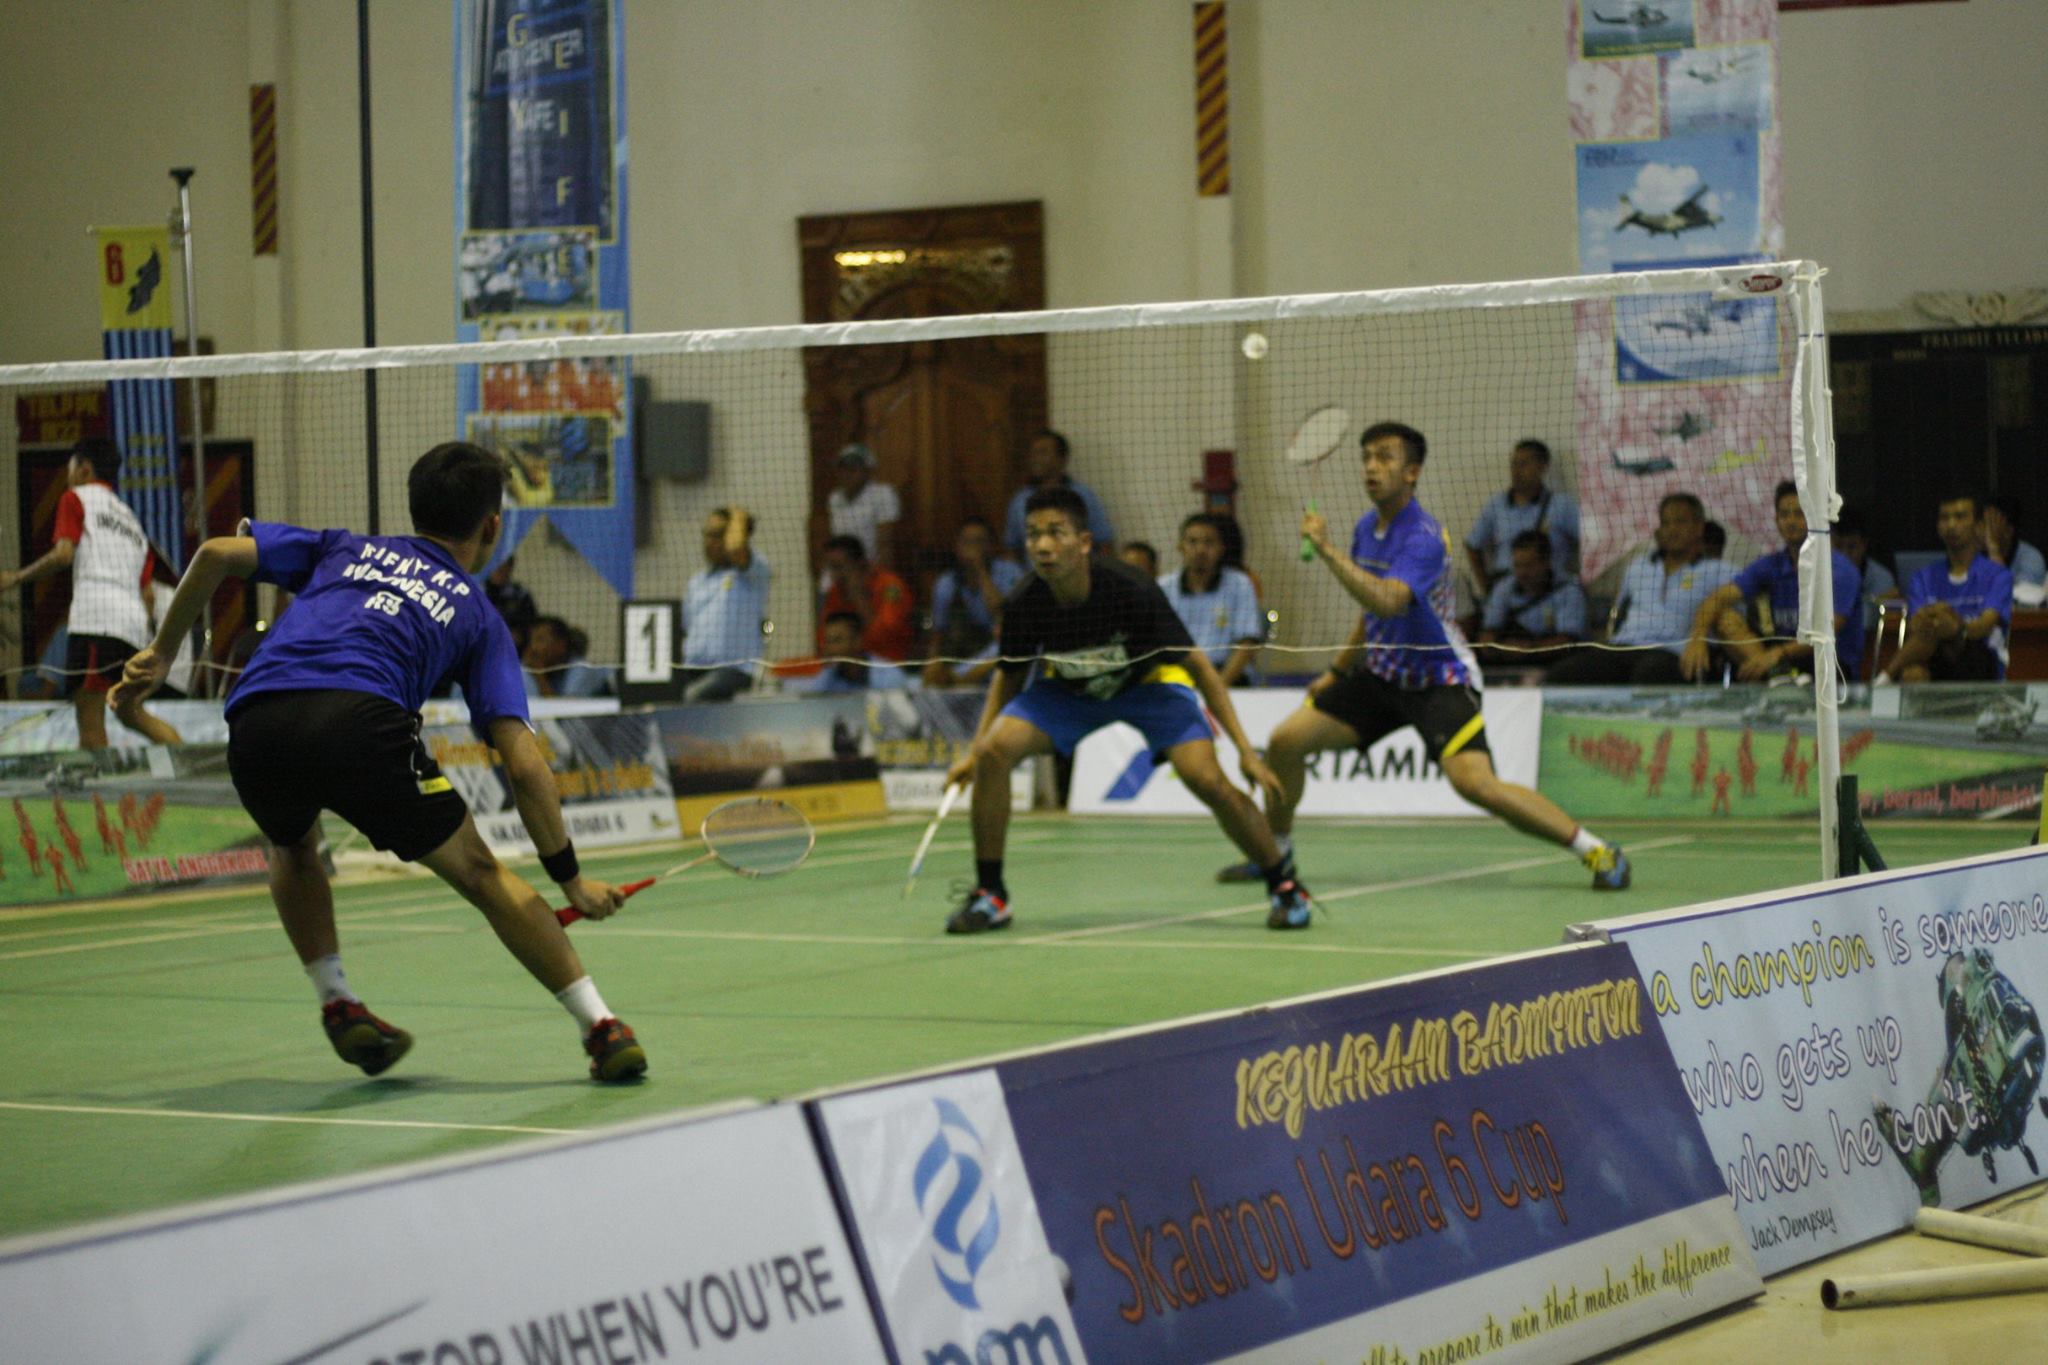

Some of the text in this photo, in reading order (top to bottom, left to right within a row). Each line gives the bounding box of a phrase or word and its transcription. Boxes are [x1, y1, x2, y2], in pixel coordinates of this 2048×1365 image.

[105, 242, 124, 286] 6
[642, 612, 657, 674] 1
[1303, 745, 1443, 781] RTAMI
[1651, 893, 2048, 1017] a champion is someone
[1452, 977, 1642, 1075] BADMINTON
[1680, 1016, 1902, 1116] who gets up
[1727, 1133, 1828, 1211] when
[1829, 1108, 1882, 1175] he
[1094, 1108, 1568, 1325] Skadron Udara 6 Cup
[1751, 1206, 1835, 1251] Jack Dempsey
[510, 1292, 667, 1365] WHEN
[664, 1246, 844, 1349] YOU'RE
[1419, 1333, 1482, 1365] prepare
[1485, 1312, 1504, 1351] to
[1510, 1304, 1542, 1342] win
[1544, 1283, 1580, 1328] that
[1584, 1266, 1630, 1315] makes
[1632, 1254, 1657, 1297] the
[1662, 1240, 1731, 1297] difference
